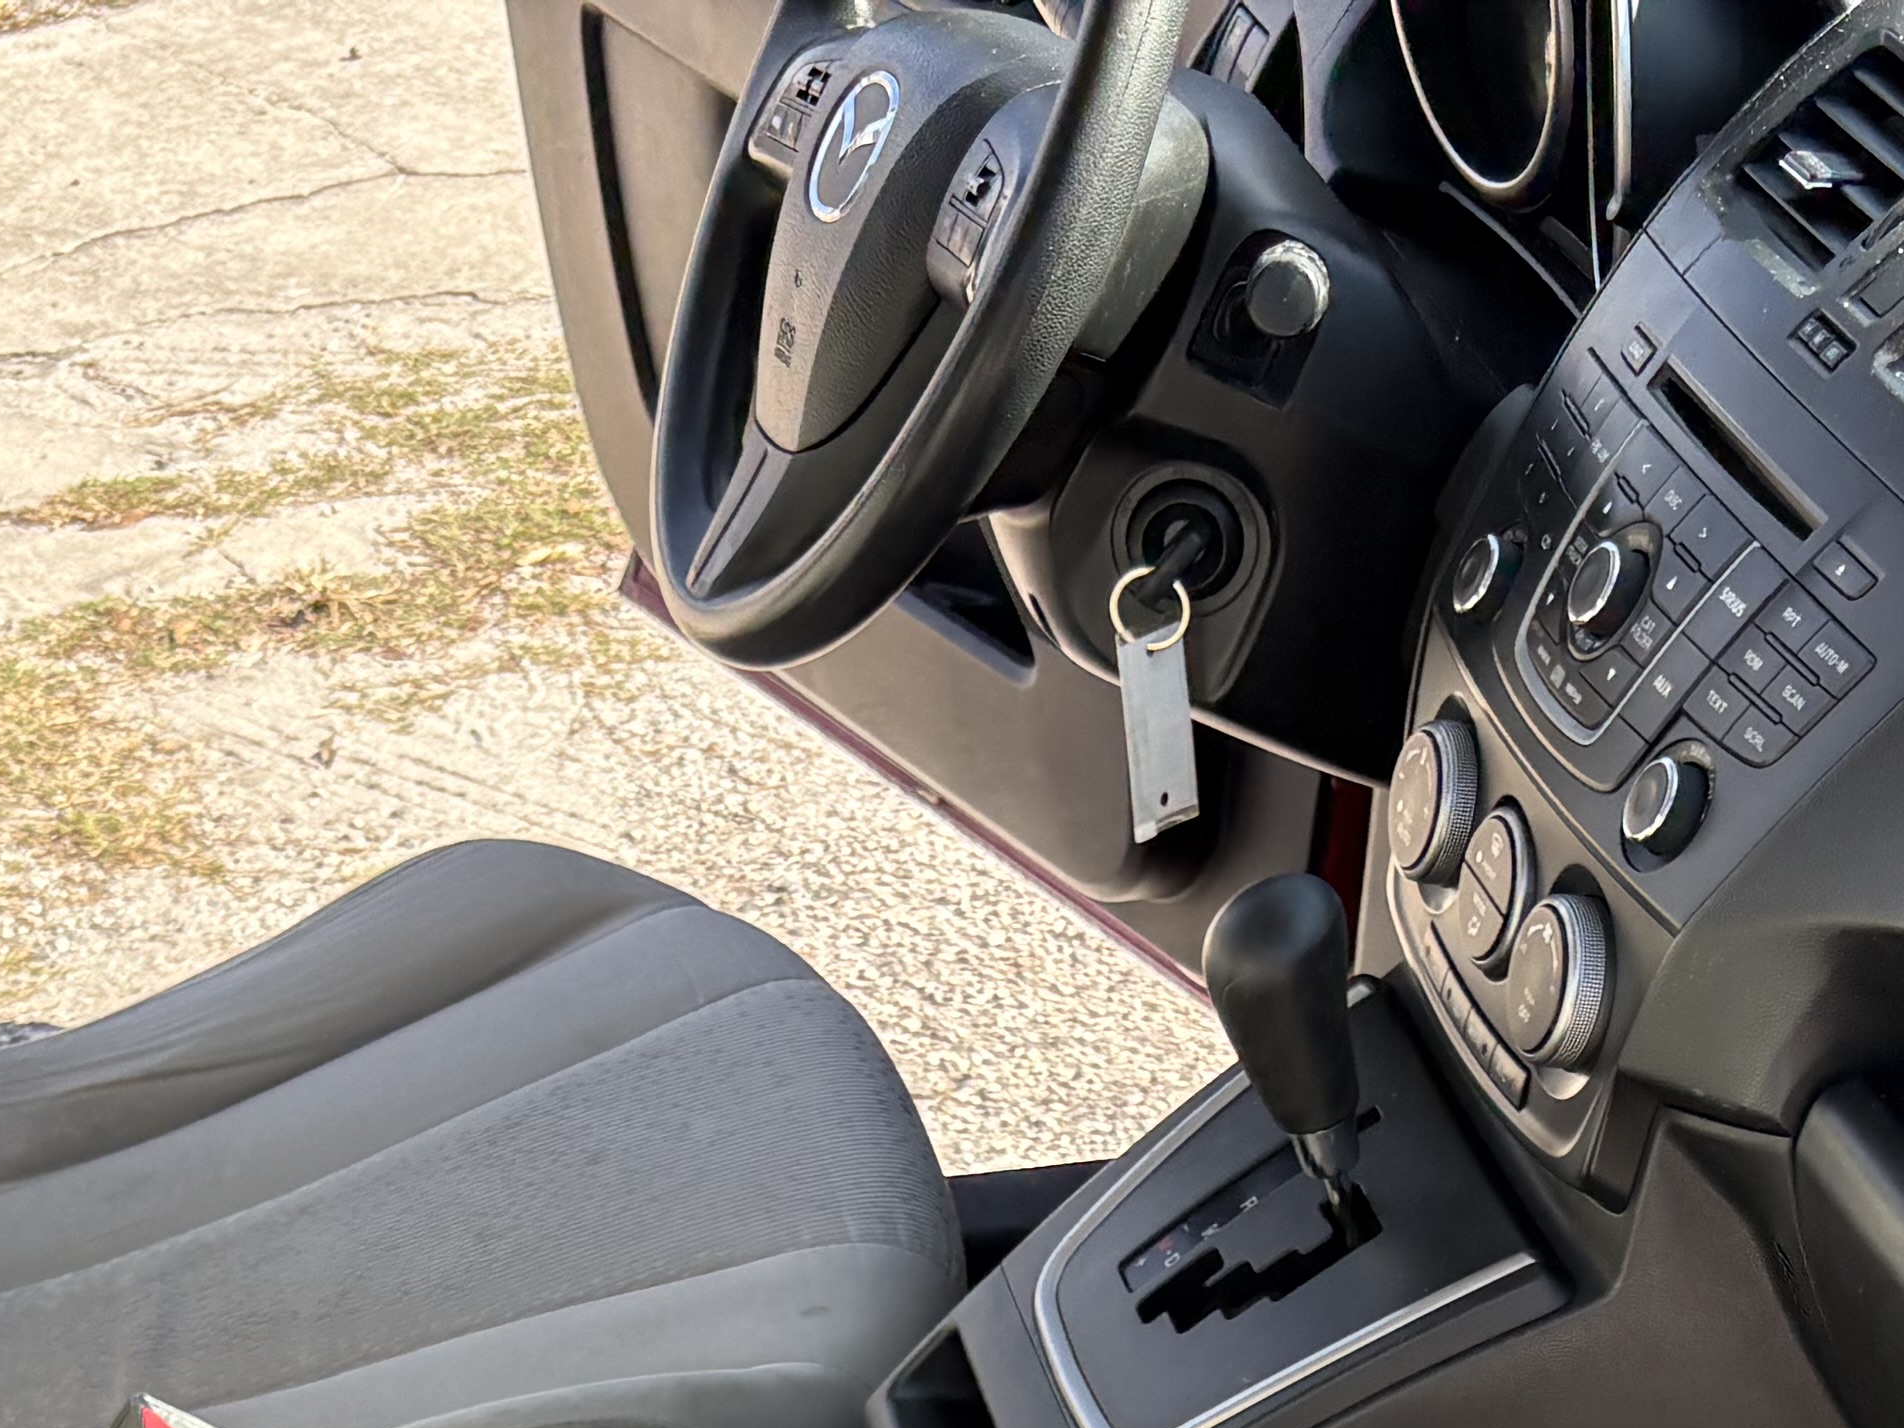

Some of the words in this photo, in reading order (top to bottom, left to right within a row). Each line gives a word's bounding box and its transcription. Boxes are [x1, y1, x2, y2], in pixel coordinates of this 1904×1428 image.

[1705, 689, 1727, 713] TEXT
[1781, 684, 1805, 710] SCAN
[1240, 1196, 1258, 1212] R
